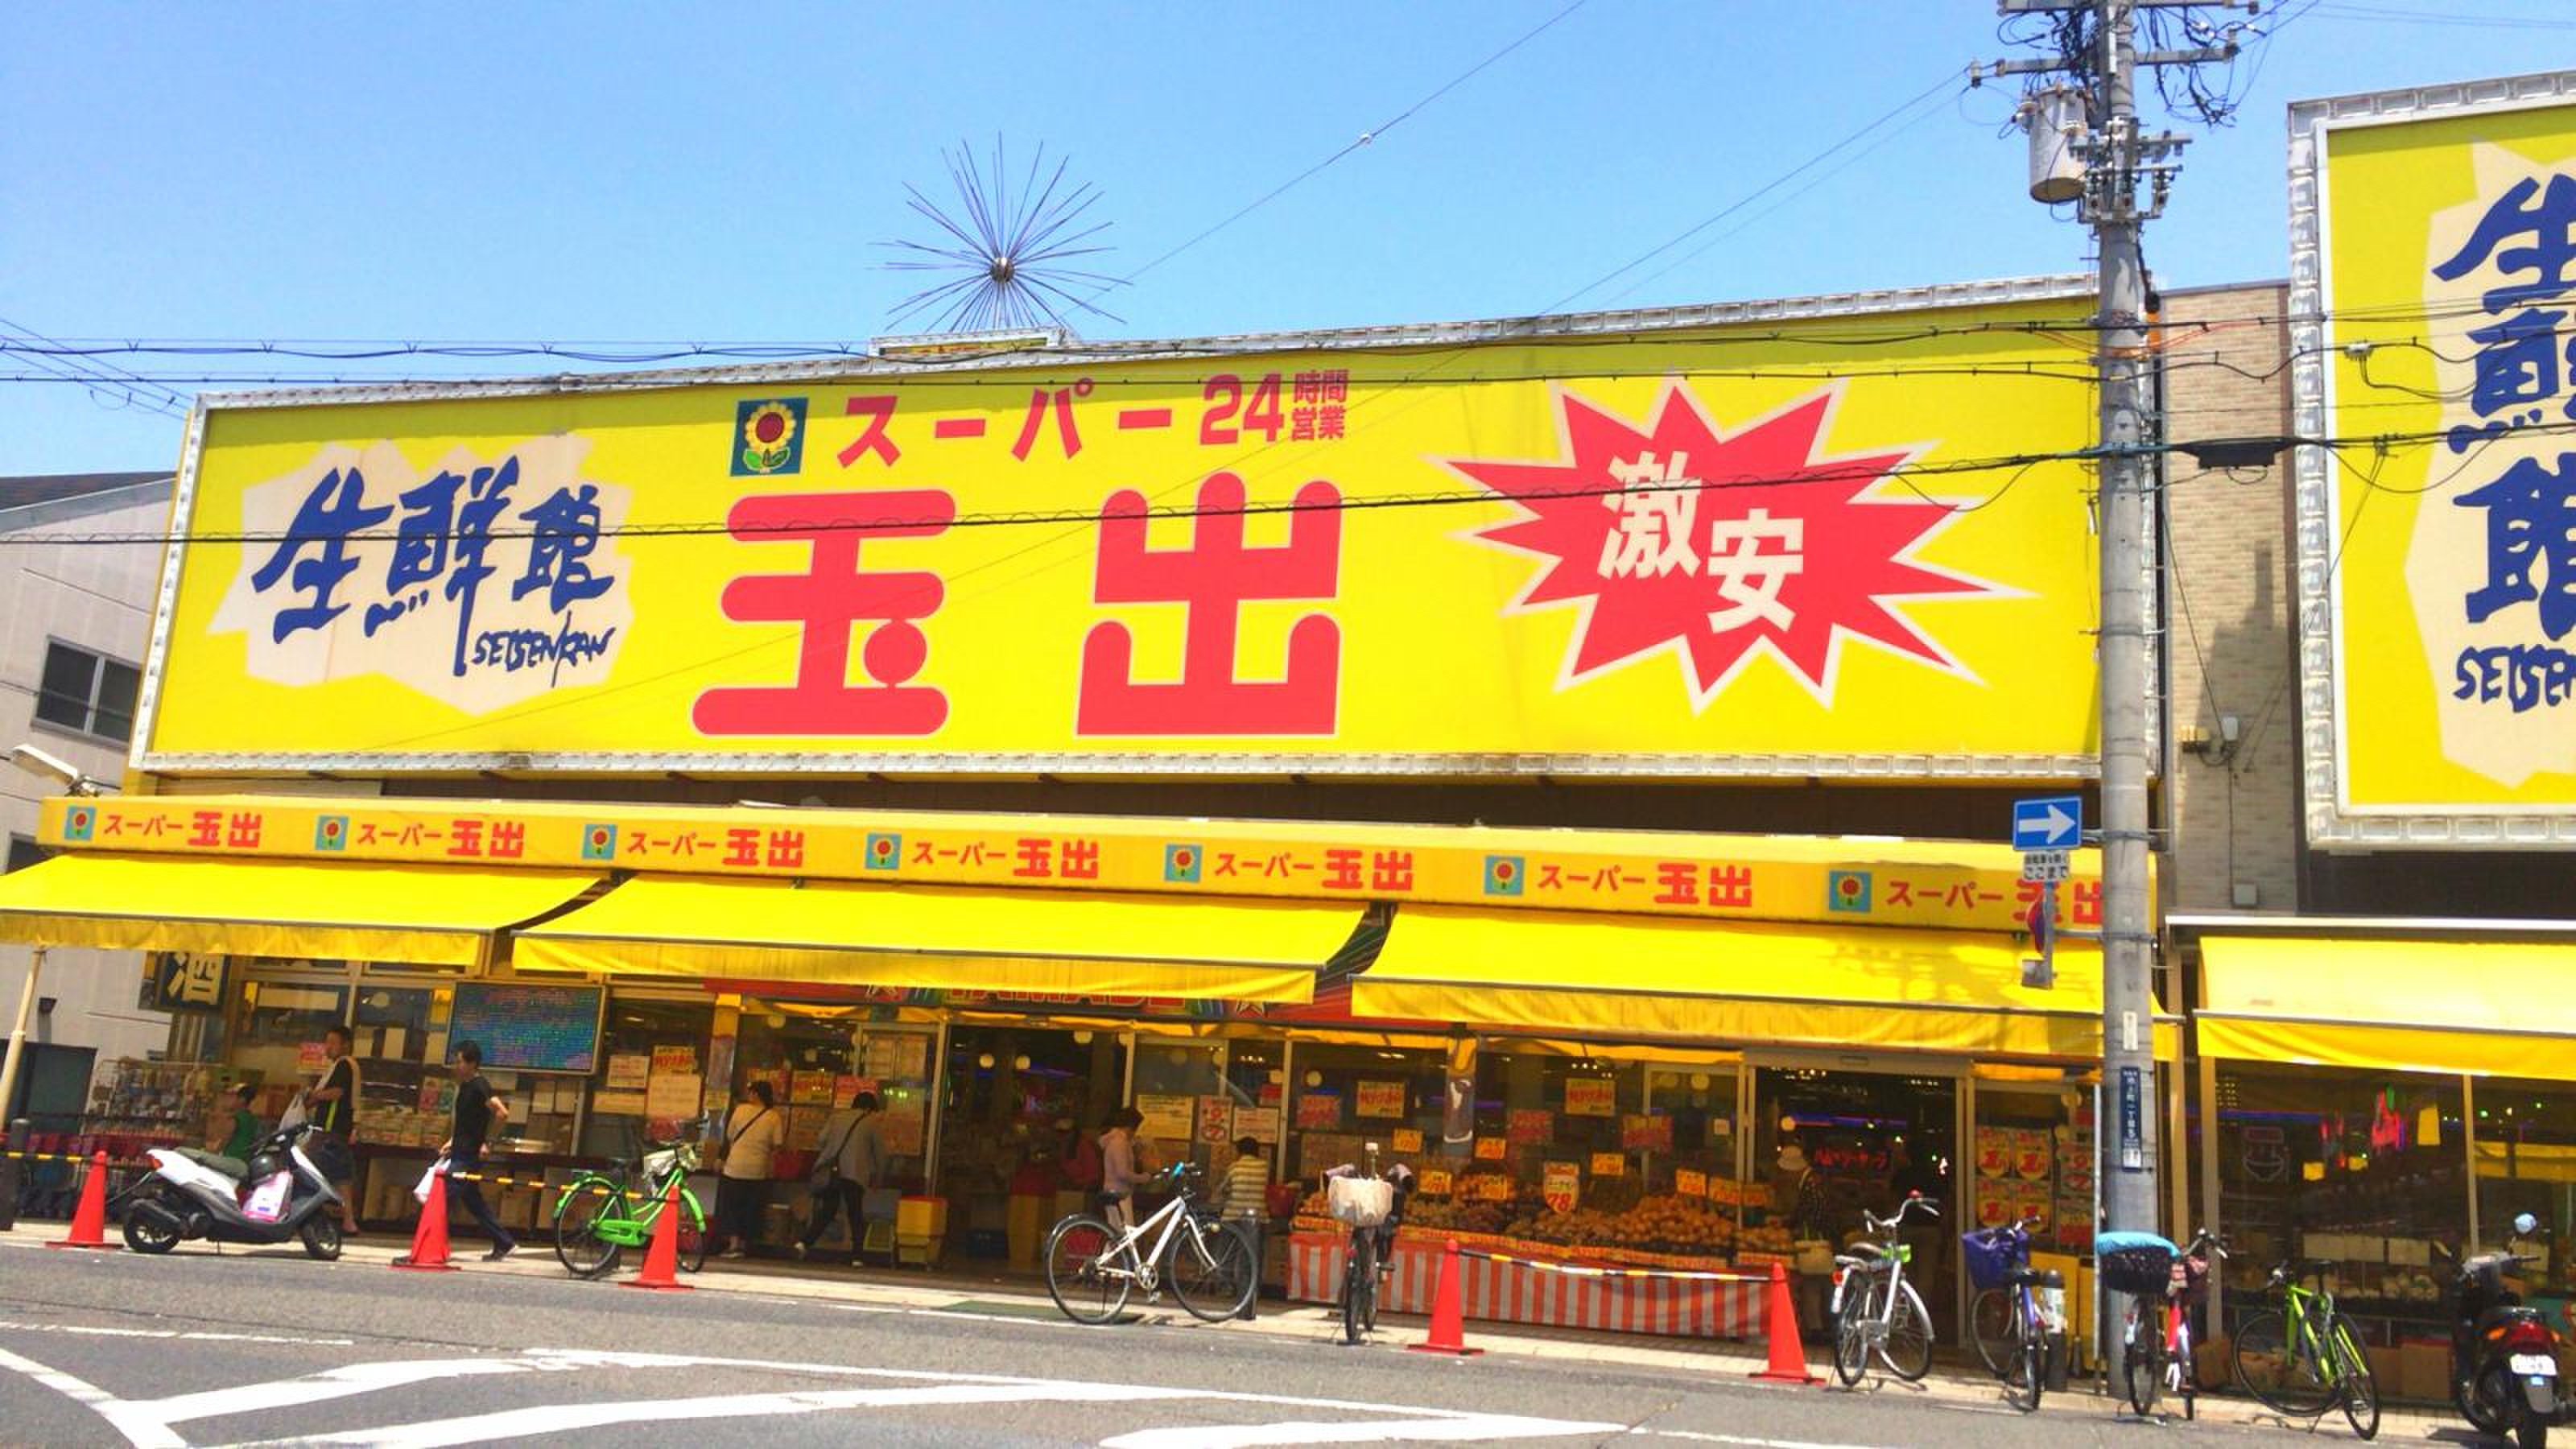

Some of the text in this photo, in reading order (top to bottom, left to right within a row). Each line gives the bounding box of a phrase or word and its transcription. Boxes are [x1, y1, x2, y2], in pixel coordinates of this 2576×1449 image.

[836, 373, 1285, 469] スーパー 24
[1290, 406, 1347, 442] 営業
[1292, 369, 1349, 404] 時間
[251, 454, 615, 676] 生鮮館
[1597, 451, 1804, 634] 激安
[472, 610, 617, 688] SEISENKAN
[691, 471, 1342, 736] 玉出
